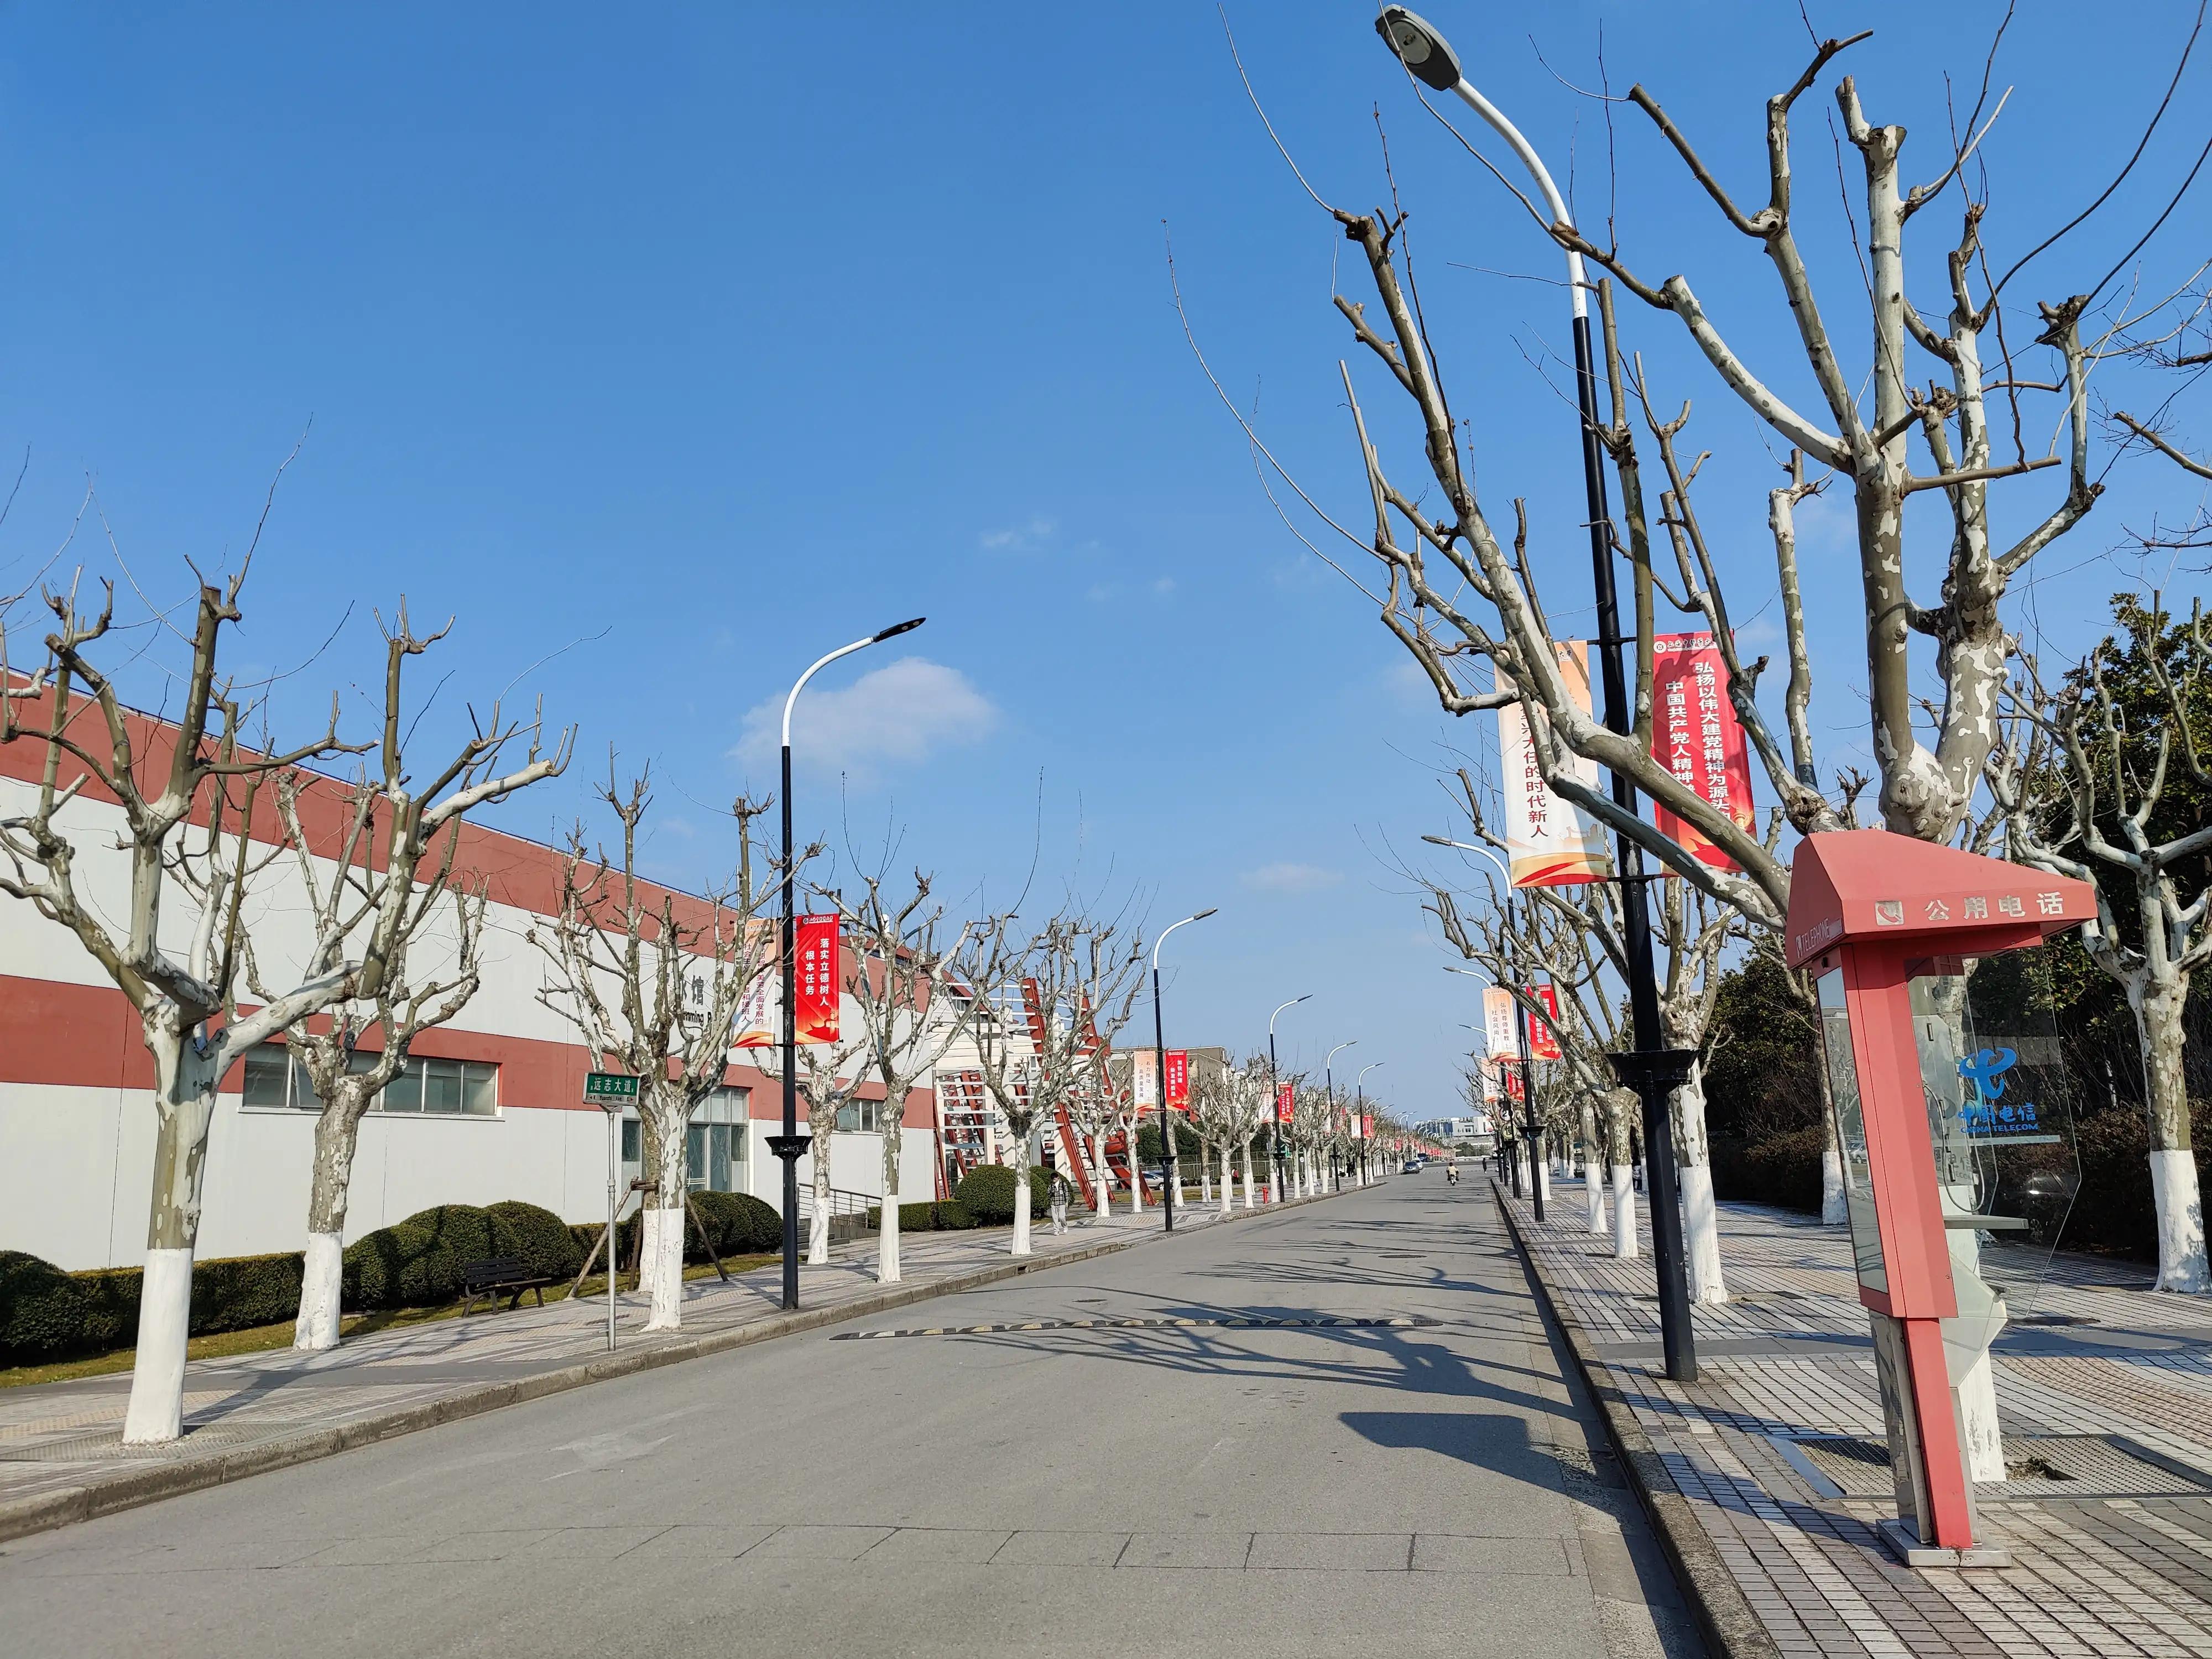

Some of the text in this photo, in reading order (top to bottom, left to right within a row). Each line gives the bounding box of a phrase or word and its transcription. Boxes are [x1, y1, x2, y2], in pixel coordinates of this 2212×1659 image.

[1925, 891, 2064, 921] 公用电话
[1802, 918, 1830, 953] TELEPHONE
[805, 951, 815, 995] 根本任务
[820, 938, 830, 1006] 落实立德树人
[1500, 1003, 1509, 1041] 弘扬尊师重教
[594, 1077, 632, 1093] 远志大道
[1958, 1102, 2036, 1126] 中国电信
[1960, 1123, 2039, 1133] CHINA TELECOM
